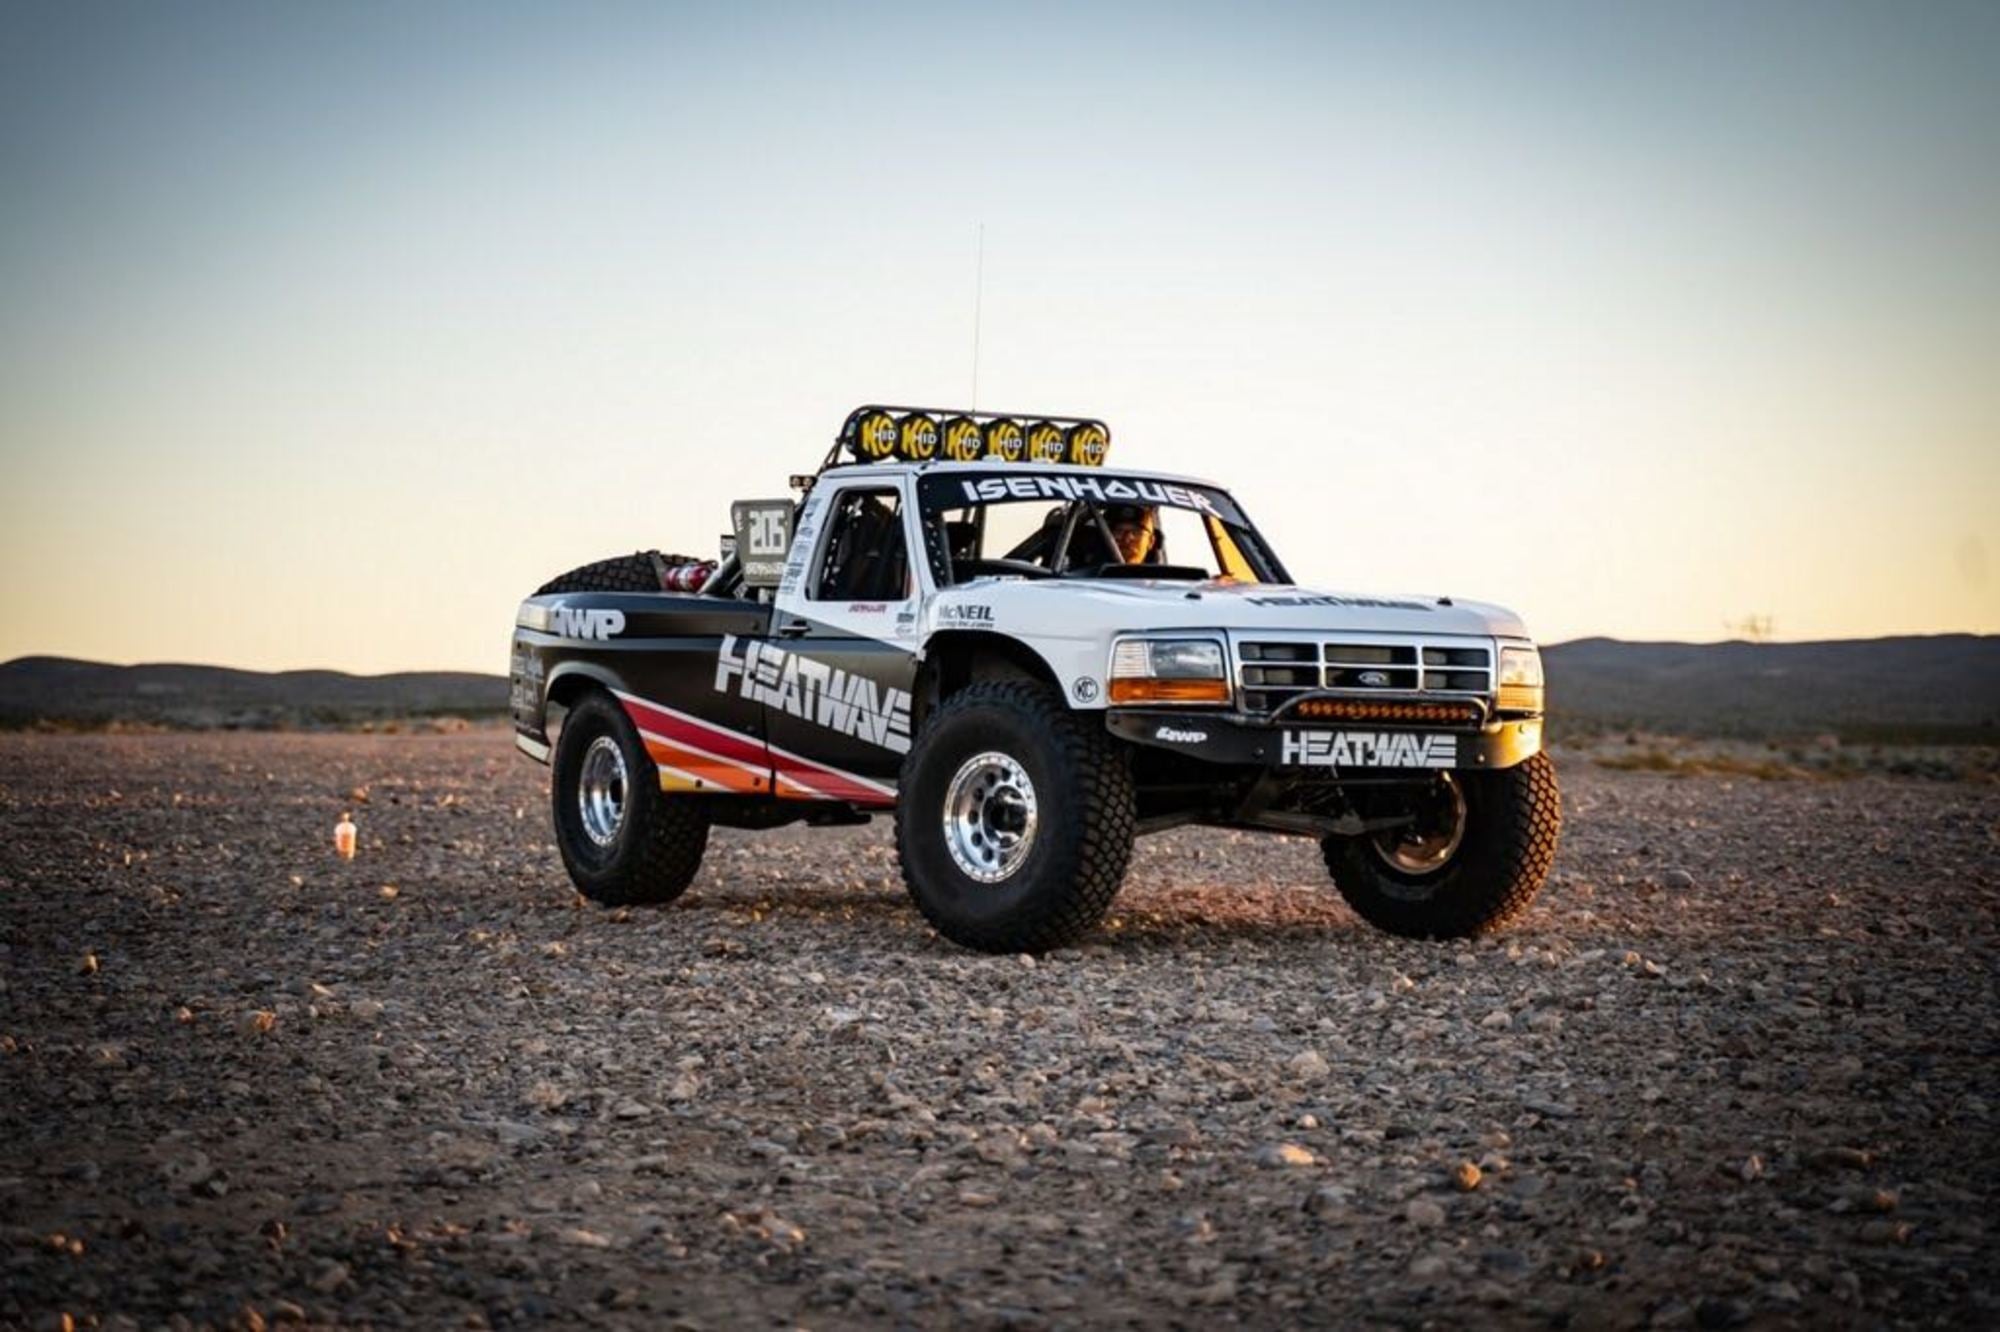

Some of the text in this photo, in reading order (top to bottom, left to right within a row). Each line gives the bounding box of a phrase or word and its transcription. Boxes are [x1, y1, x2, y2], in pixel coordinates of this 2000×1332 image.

[862, 415, 897, 456] KC HID
[902, 418, 937, 458] KC HID
[949, 421, 981, 461] KC HID
[988, 421, 1023, 461] KC HID
[1030, 426, 1064, 464] KC HID
[1071, 424, 1107, 466] KC HID
[749, 509, 787, 554] 205
[939, 604, 995, 621] McNEIL
[714, 633, 912, 755] HEATWAVE
[1077, 680, 1094, 700] KC
[1282, 730, 1457, 768] HEATWAVE
